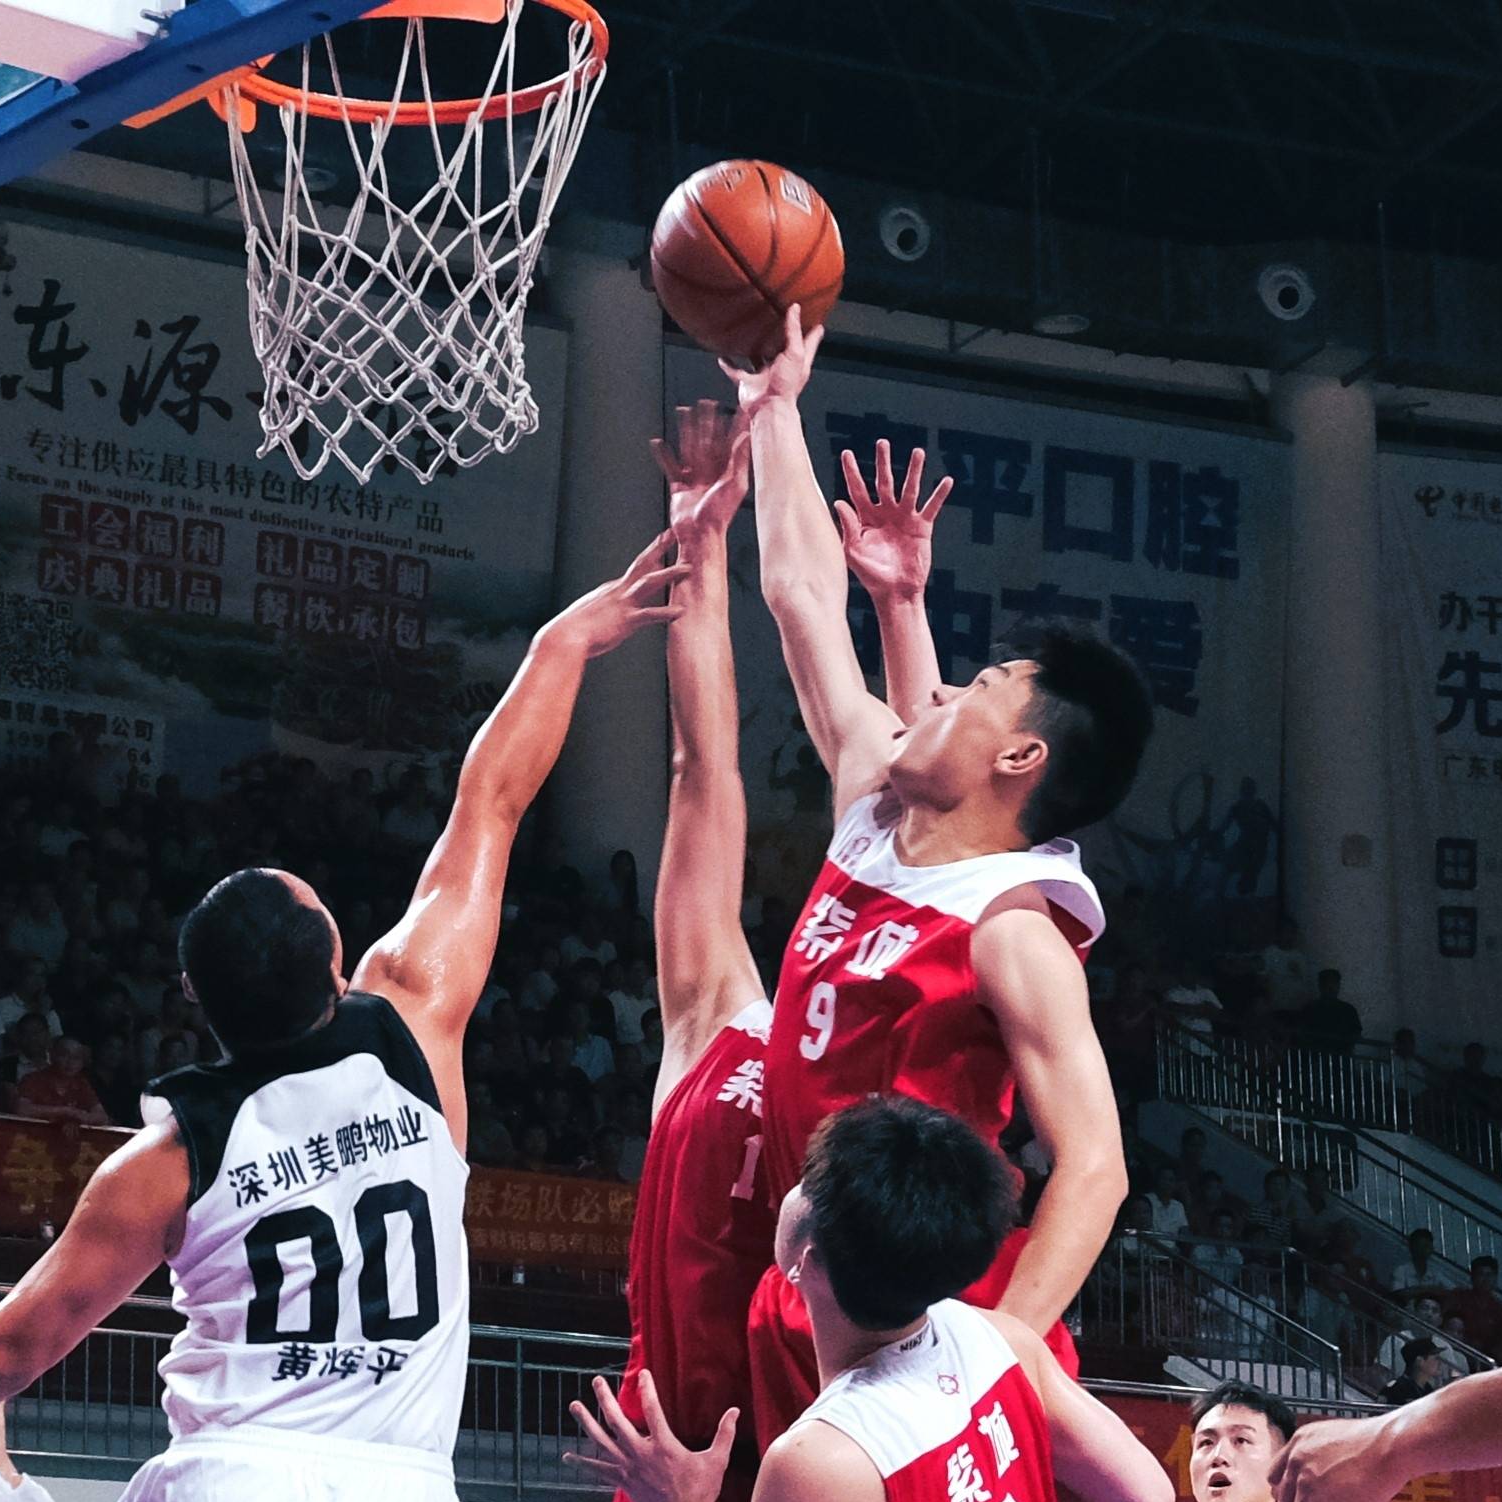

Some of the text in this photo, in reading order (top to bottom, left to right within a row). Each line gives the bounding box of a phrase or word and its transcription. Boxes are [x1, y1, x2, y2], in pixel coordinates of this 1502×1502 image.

[6, 466, 476, 561] Focus on the supply of the most distinctive agricultural products
[27, 428, 444, 534] 专注供应最具特色的农特产品
[41, 550, 425, 648] 庆典礼品 餐饮承包
[45, 499, 427, 600] 工会福利 礼品定制
[798, 981, 838, 1061] 9
[227, 1105, 429, 1208] 深圳美鹏物业
[243, 1179, 440, 1345] 00
